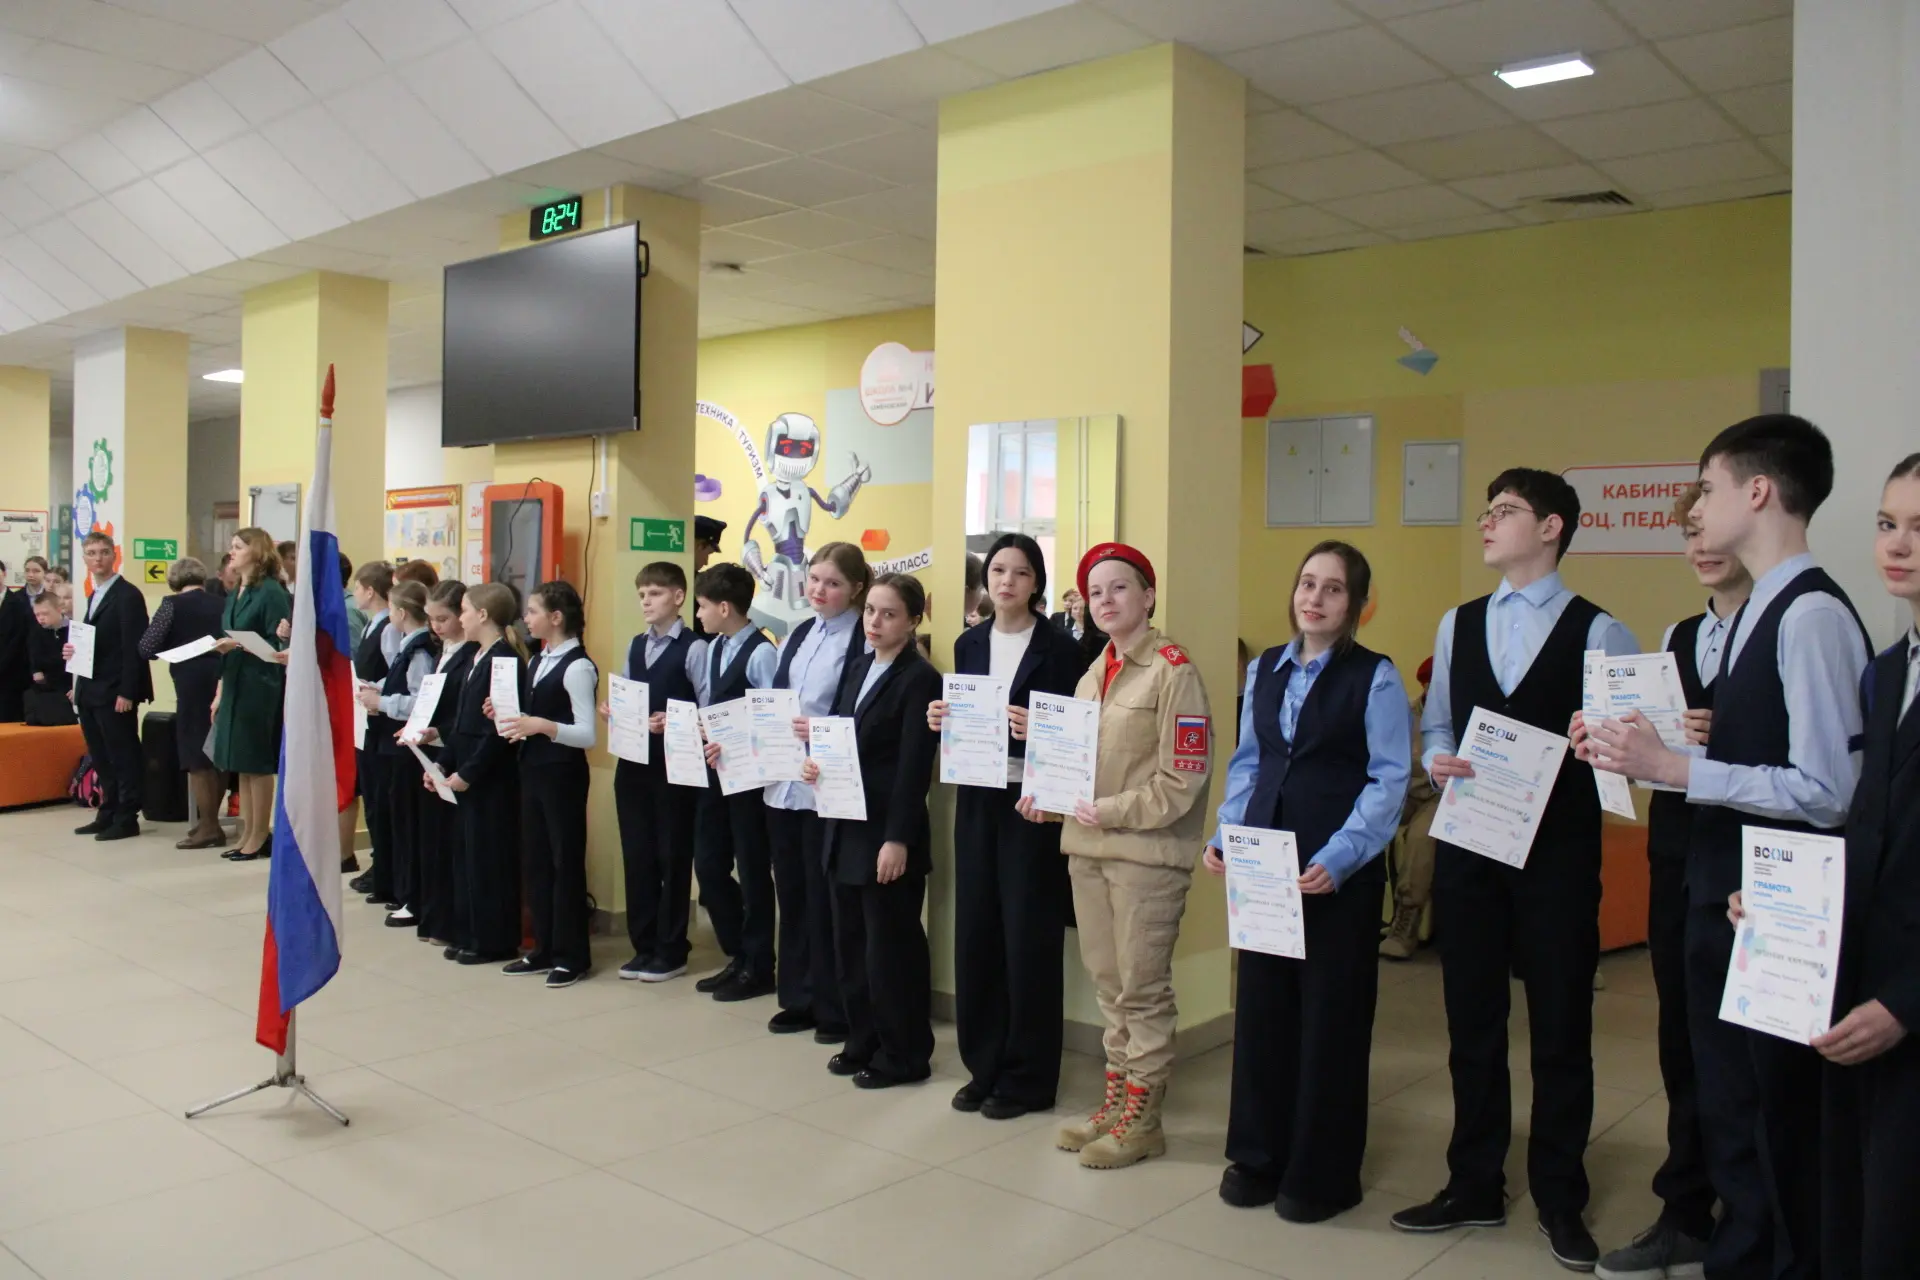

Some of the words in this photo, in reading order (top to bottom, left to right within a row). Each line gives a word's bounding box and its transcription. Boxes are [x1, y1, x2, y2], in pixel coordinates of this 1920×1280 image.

[542, 202, 578, 234] 8:24
[739, 430, 763, 479] ТУРИЗМ
[892, 553, 929, 573] КЛАСС
[1753, 880, 1792, 893] ГРАМОТА
